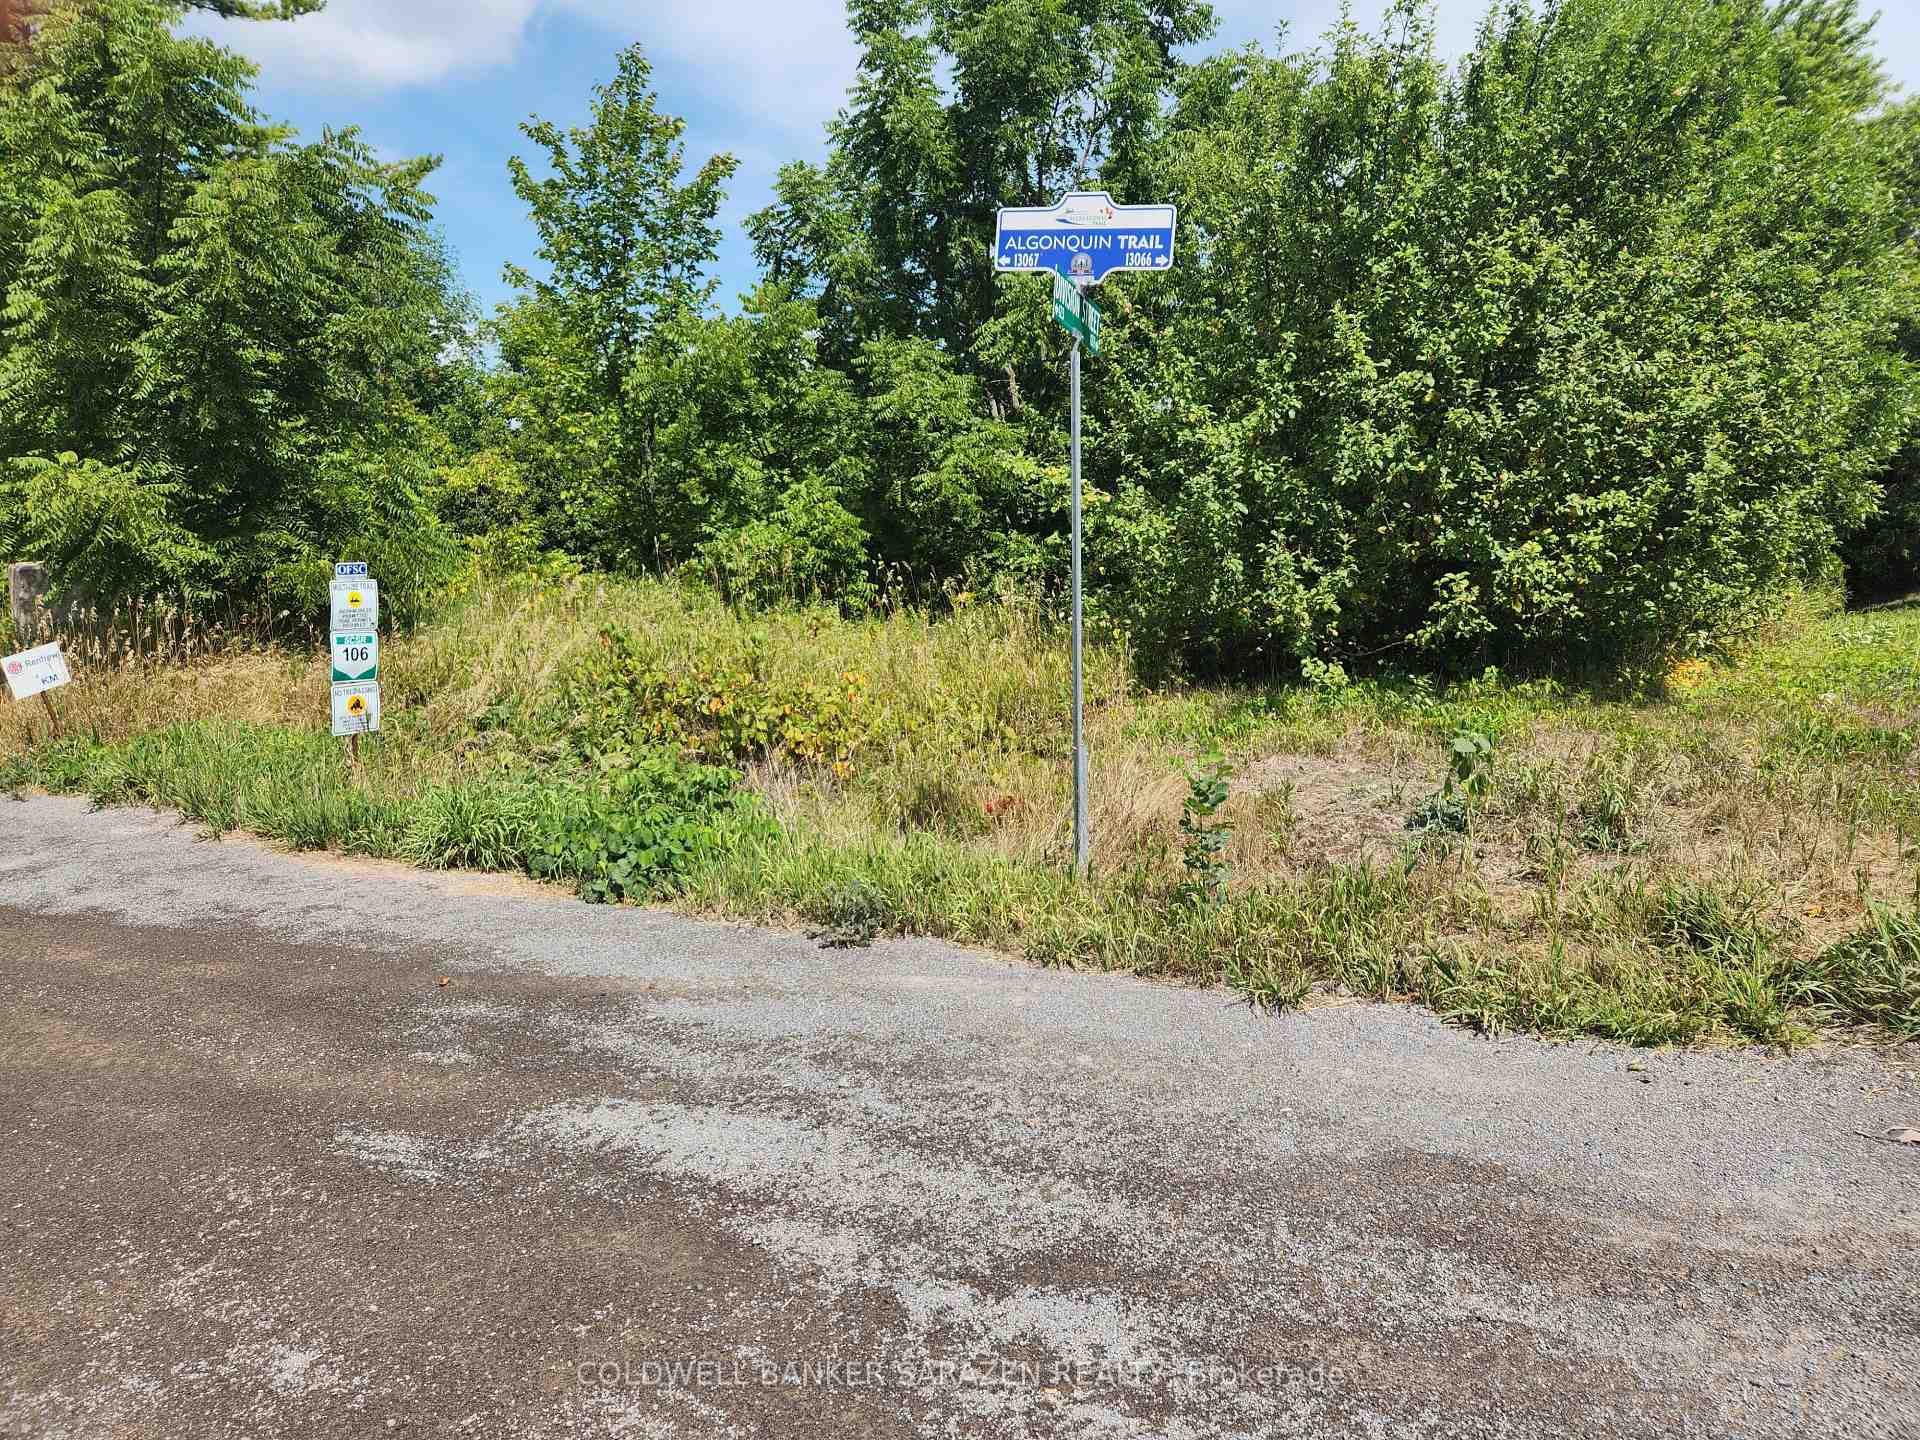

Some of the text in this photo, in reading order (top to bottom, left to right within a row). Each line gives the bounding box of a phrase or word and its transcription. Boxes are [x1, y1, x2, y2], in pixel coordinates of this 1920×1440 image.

[1004, 234, 1164, 252] ALGONQUIN TRAIL
[1014, 253, 1039, 267] 13067
[1125, 252, 1152, 266] 13066
[338, 564, 366, 574] OFSC
[343, 647, 369, 662] 106
